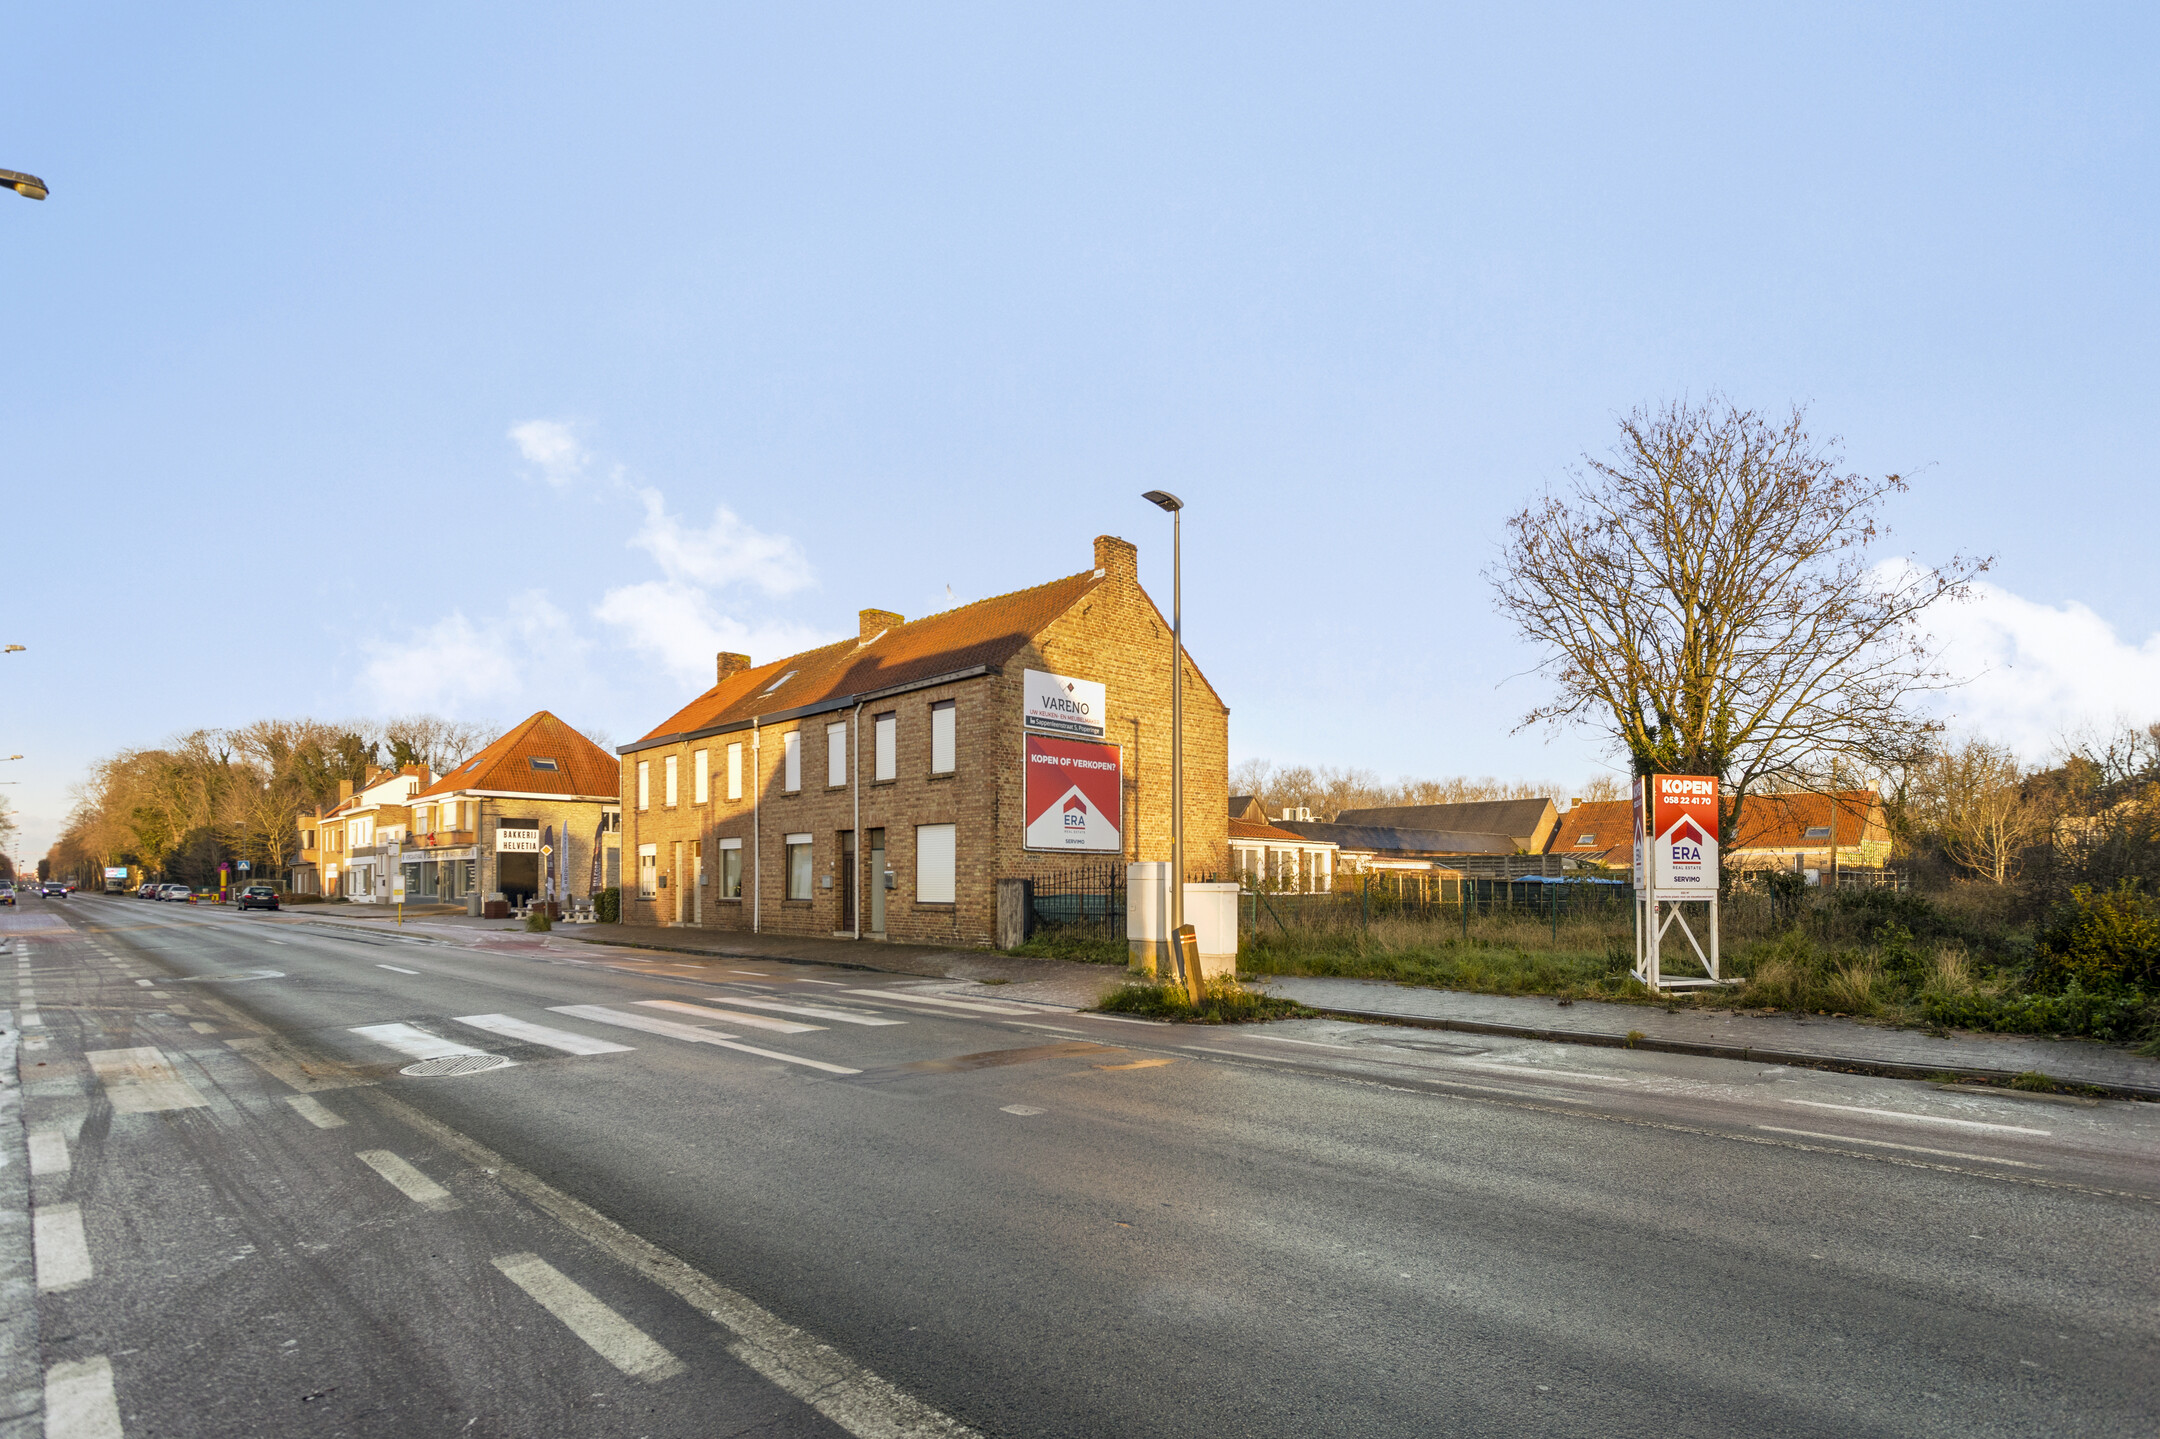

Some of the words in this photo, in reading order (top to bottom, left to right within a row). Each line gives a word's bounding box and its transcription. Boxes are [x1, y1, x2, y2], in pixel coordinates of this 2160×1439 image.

[1042, 696, 1089, 715] VARENO
[1031, 754, 1058, 764] KOPEN
[1060, 757, 1071, 766] OF
[1072, 758, 1116, 770] VERKOPEN?
[1662, 779, 1712, 794] KOPEN
[1663, 796, 1679, 804] 058
[1680, 796, 1690, 804] 22
[1691, 797, 1700, 805] 41
[1701, 797, 1711, 805] 70
[1064, 815, 1085, 826] ERA
[503, 830, 537, 839] BAKKERIJ
[503, 841, 537, 850] HELVETIA
[1672, 846, 1701, 860] ERA
